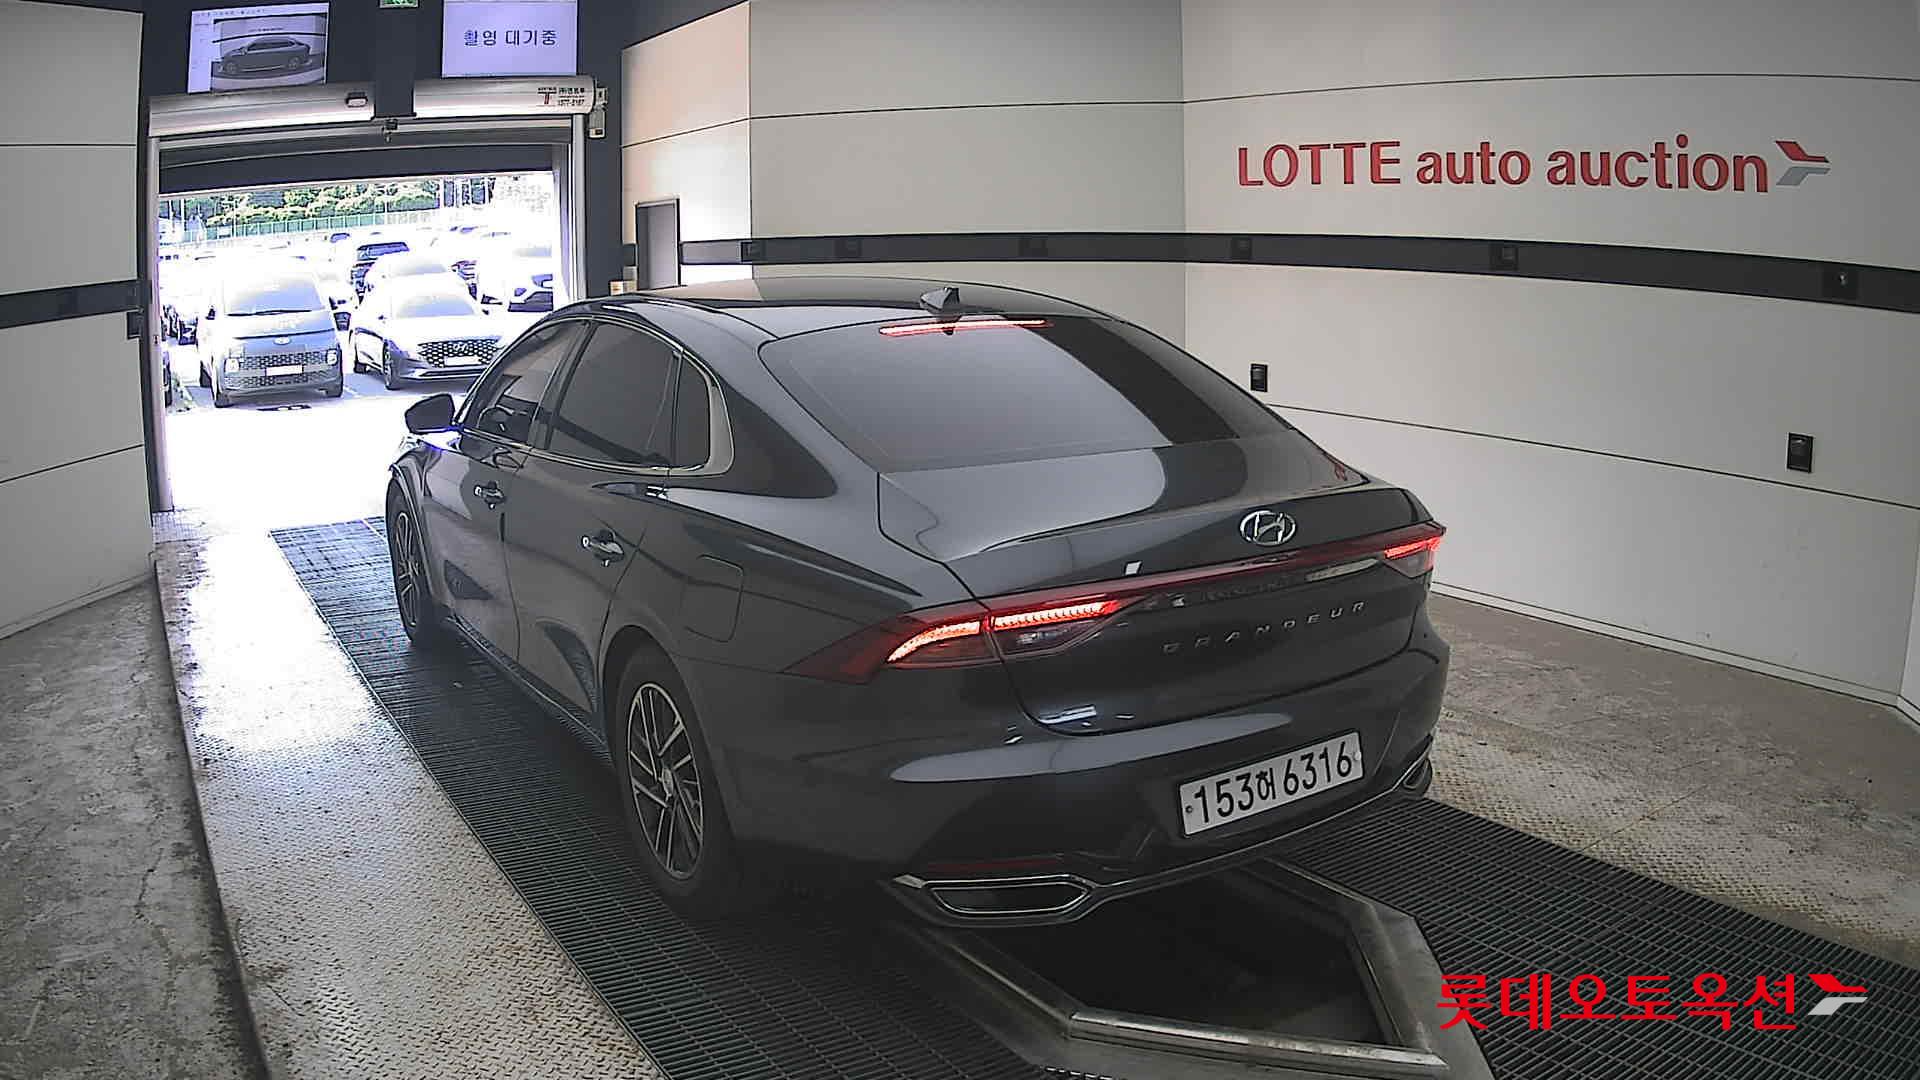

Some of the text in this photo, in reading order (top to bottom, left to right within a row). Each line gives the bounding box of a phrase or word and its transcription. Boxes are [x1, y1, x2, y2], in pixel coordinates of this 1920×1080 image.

[505, 29, 557, 46] 대기중
[1238, 133, 1768, 193] LOTTE auto auction
[1163, 601, 1366, 654] GRANDEUR
[1283, 741, 1353, 796] 6316
